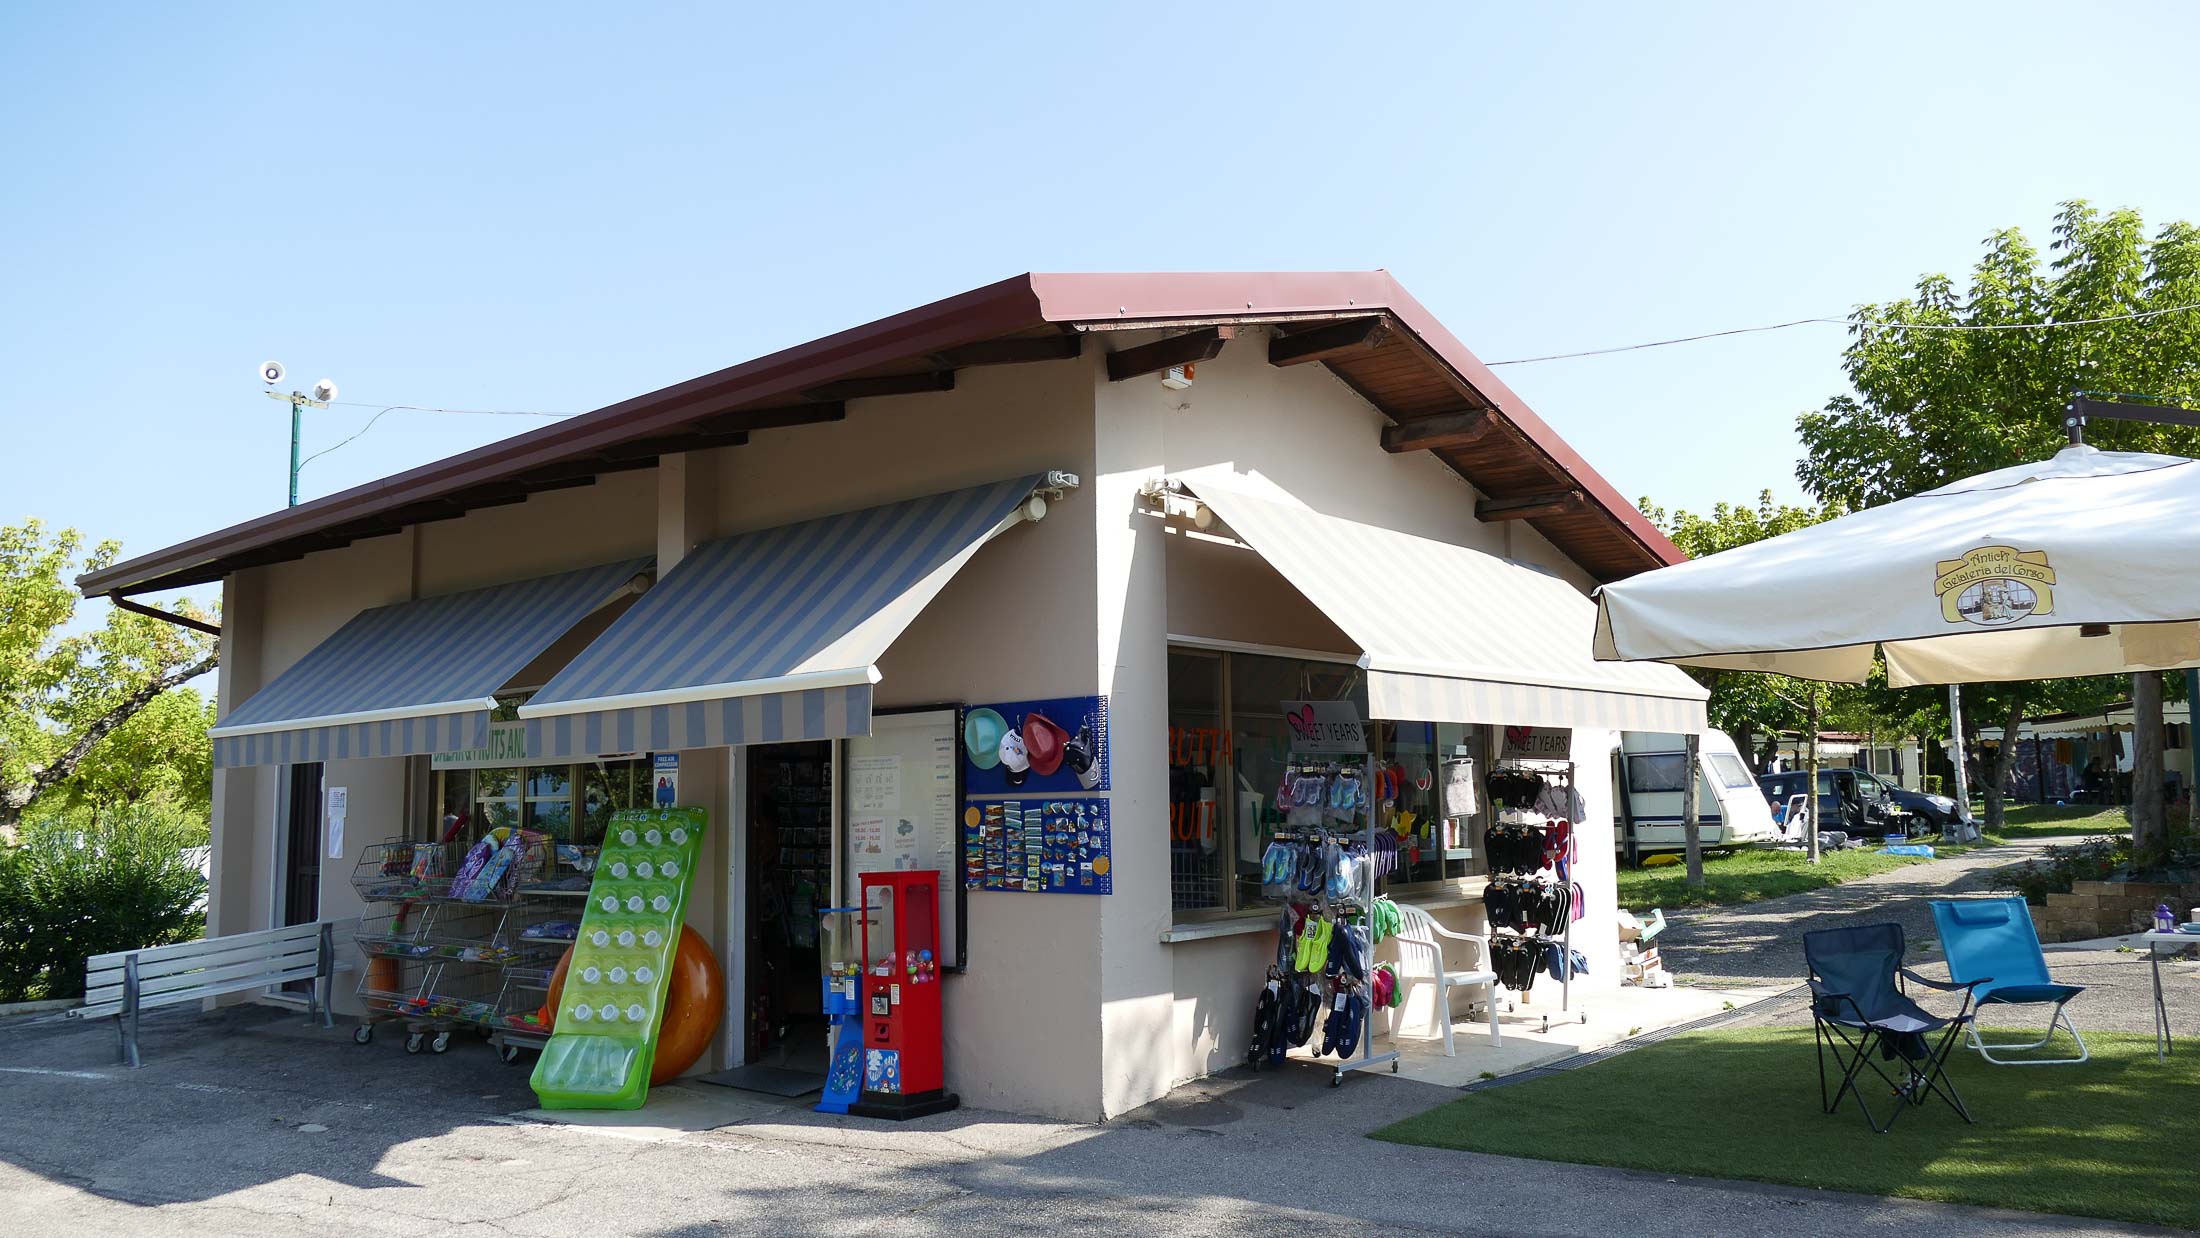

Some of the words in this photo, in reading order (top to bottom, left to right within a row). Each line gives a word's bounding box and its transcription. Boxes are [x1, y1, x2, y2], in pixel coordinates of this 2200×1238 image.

[1942, 566, 1992, 589] Gelateria
[1994, 565, 2011, 576] del
[2013, 565, 2045, 580] Corso
[1293, 722, 1326, 742] SWEET
[1327, 722, 1360, 742] YEARS
[1507, 735, 1538, 751] SWEET
[1539, 735, 1567, 752] YEARS
[1168, 726, 1233, 766] RUTTA
[1169, 800, 1217, 842] RUIT
